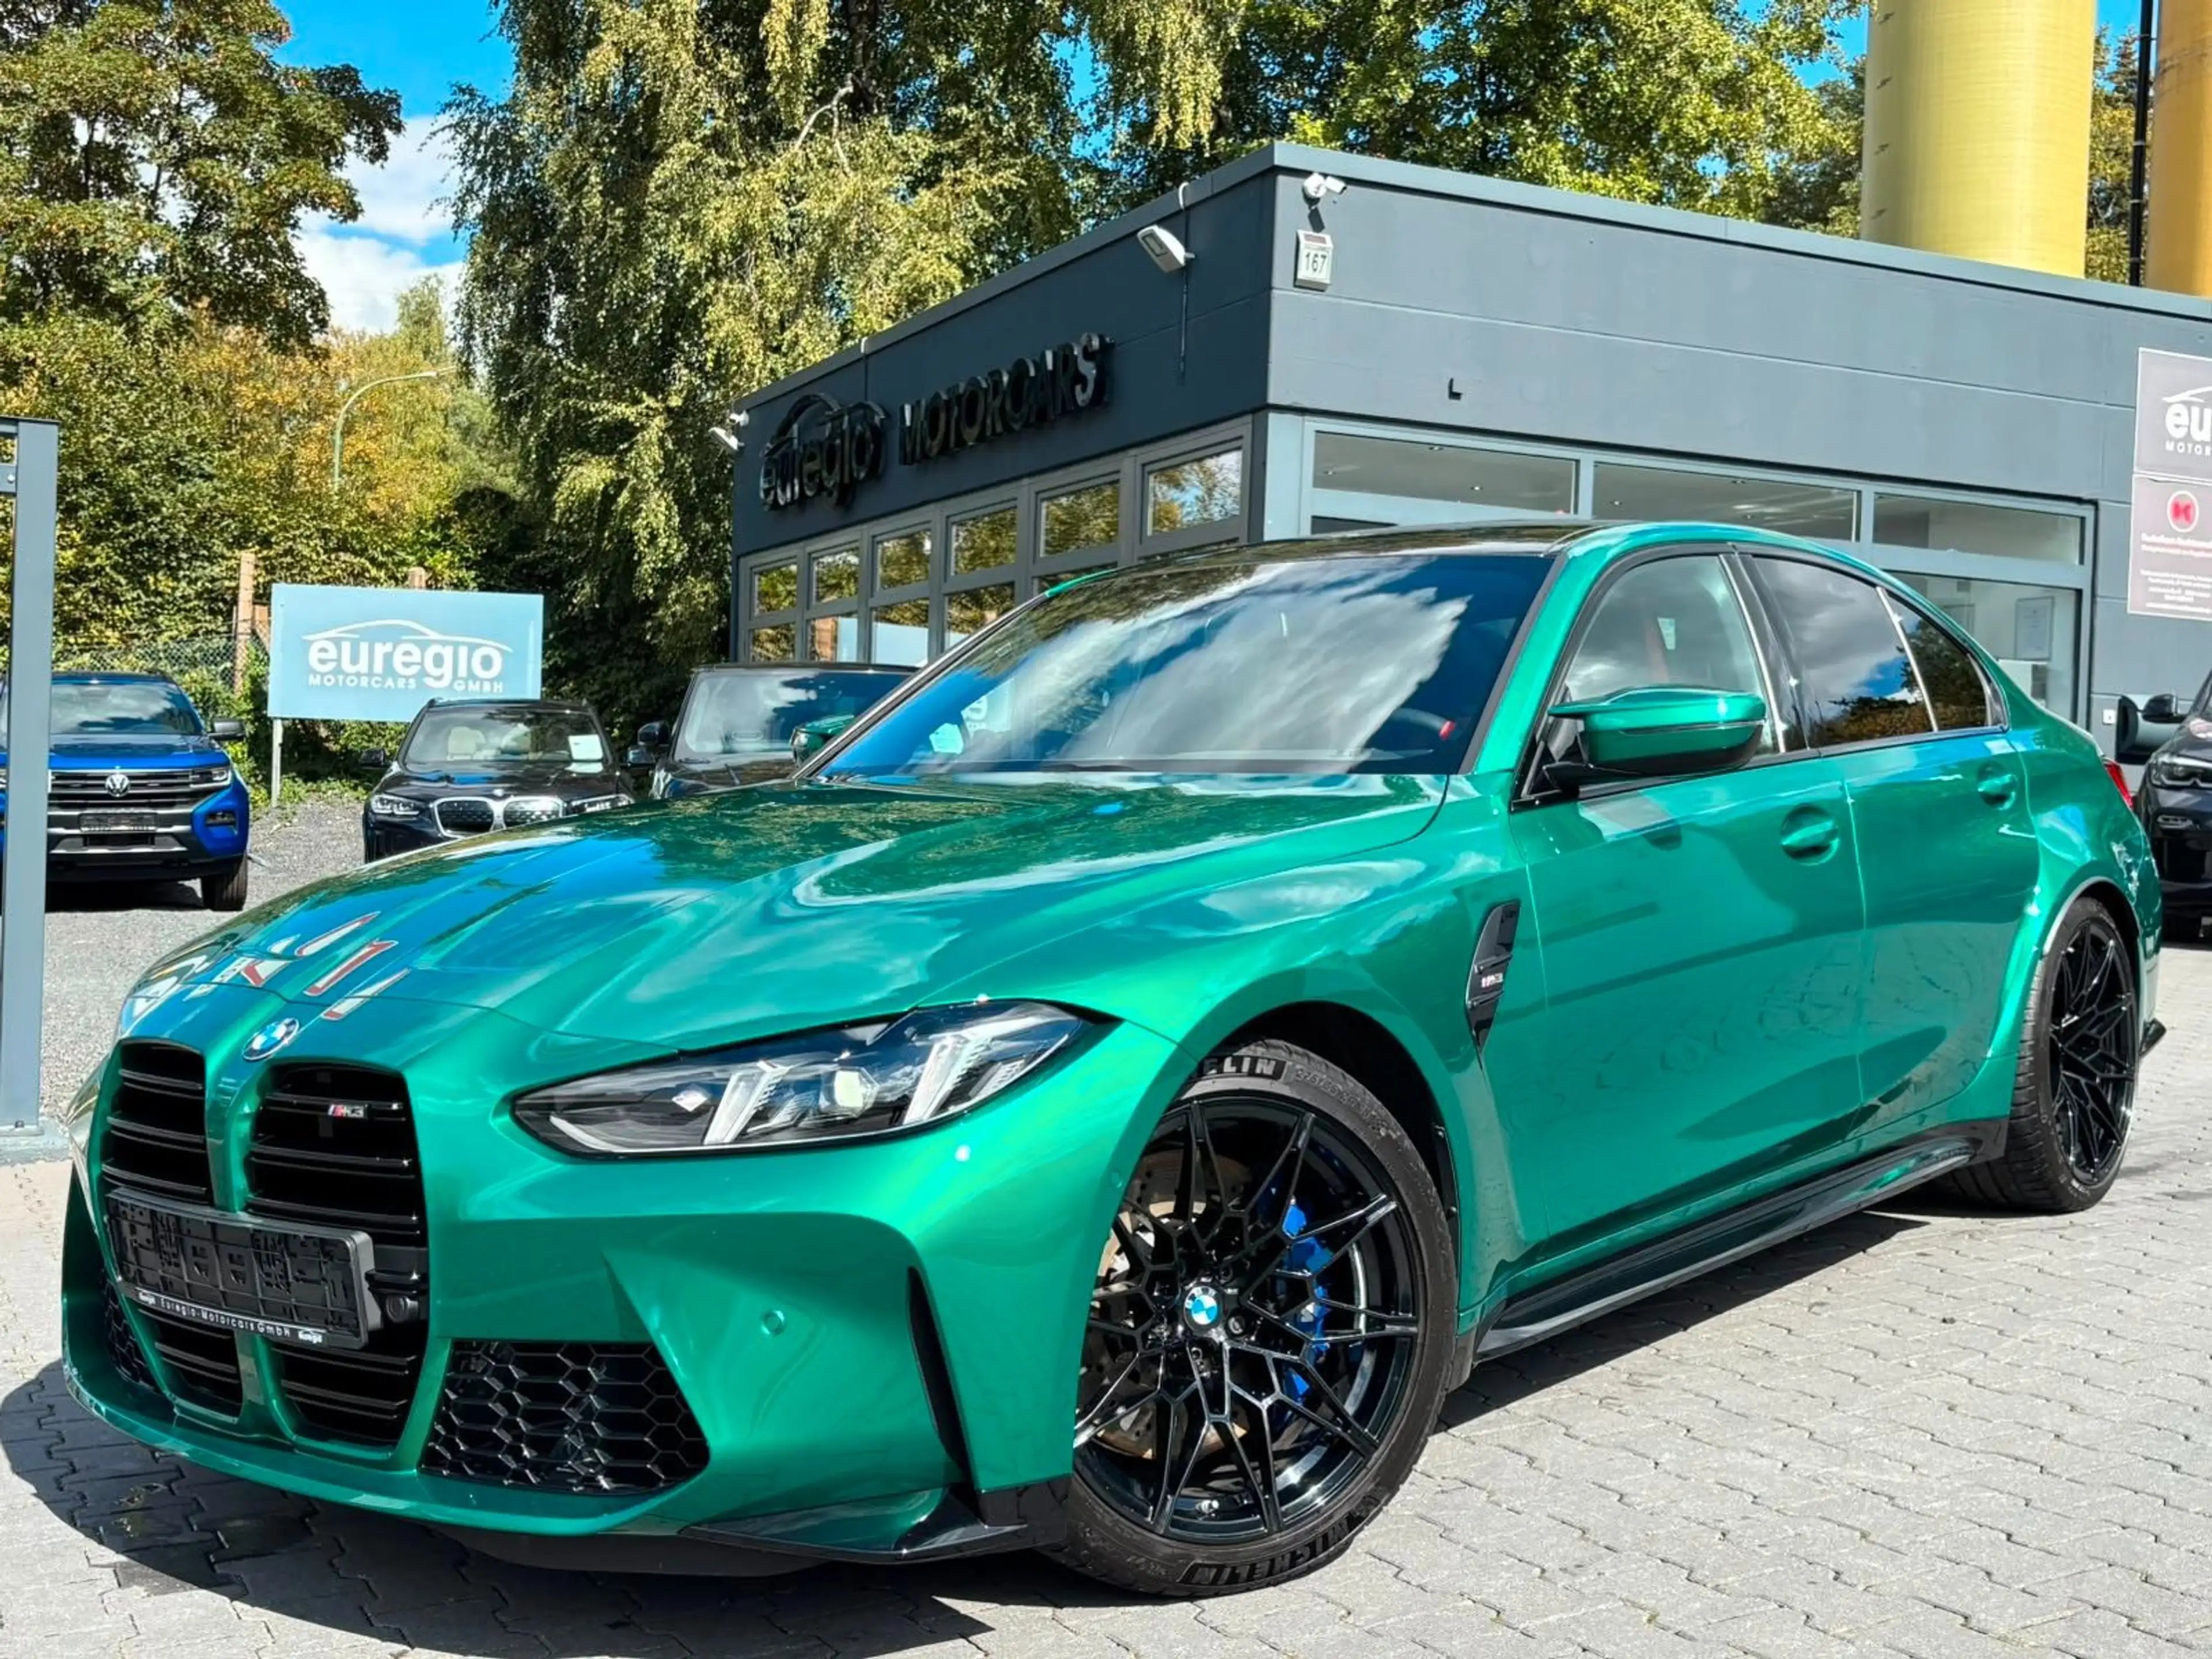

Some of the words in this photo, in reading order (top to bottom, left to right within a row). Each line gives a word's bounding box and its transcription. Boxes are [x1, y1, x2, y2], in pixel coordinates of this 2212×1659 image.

[1305, 252, 1327, 274] 167
[899, 332, 1101, 465] MOTORCARS
[308, 639, 502, 688] euregio
[309, 674, 416, 690] MOTORCARS
[453, 679, 503, 694] GMBH
[1192, 1518, 1350, 1585] MICHELIN
